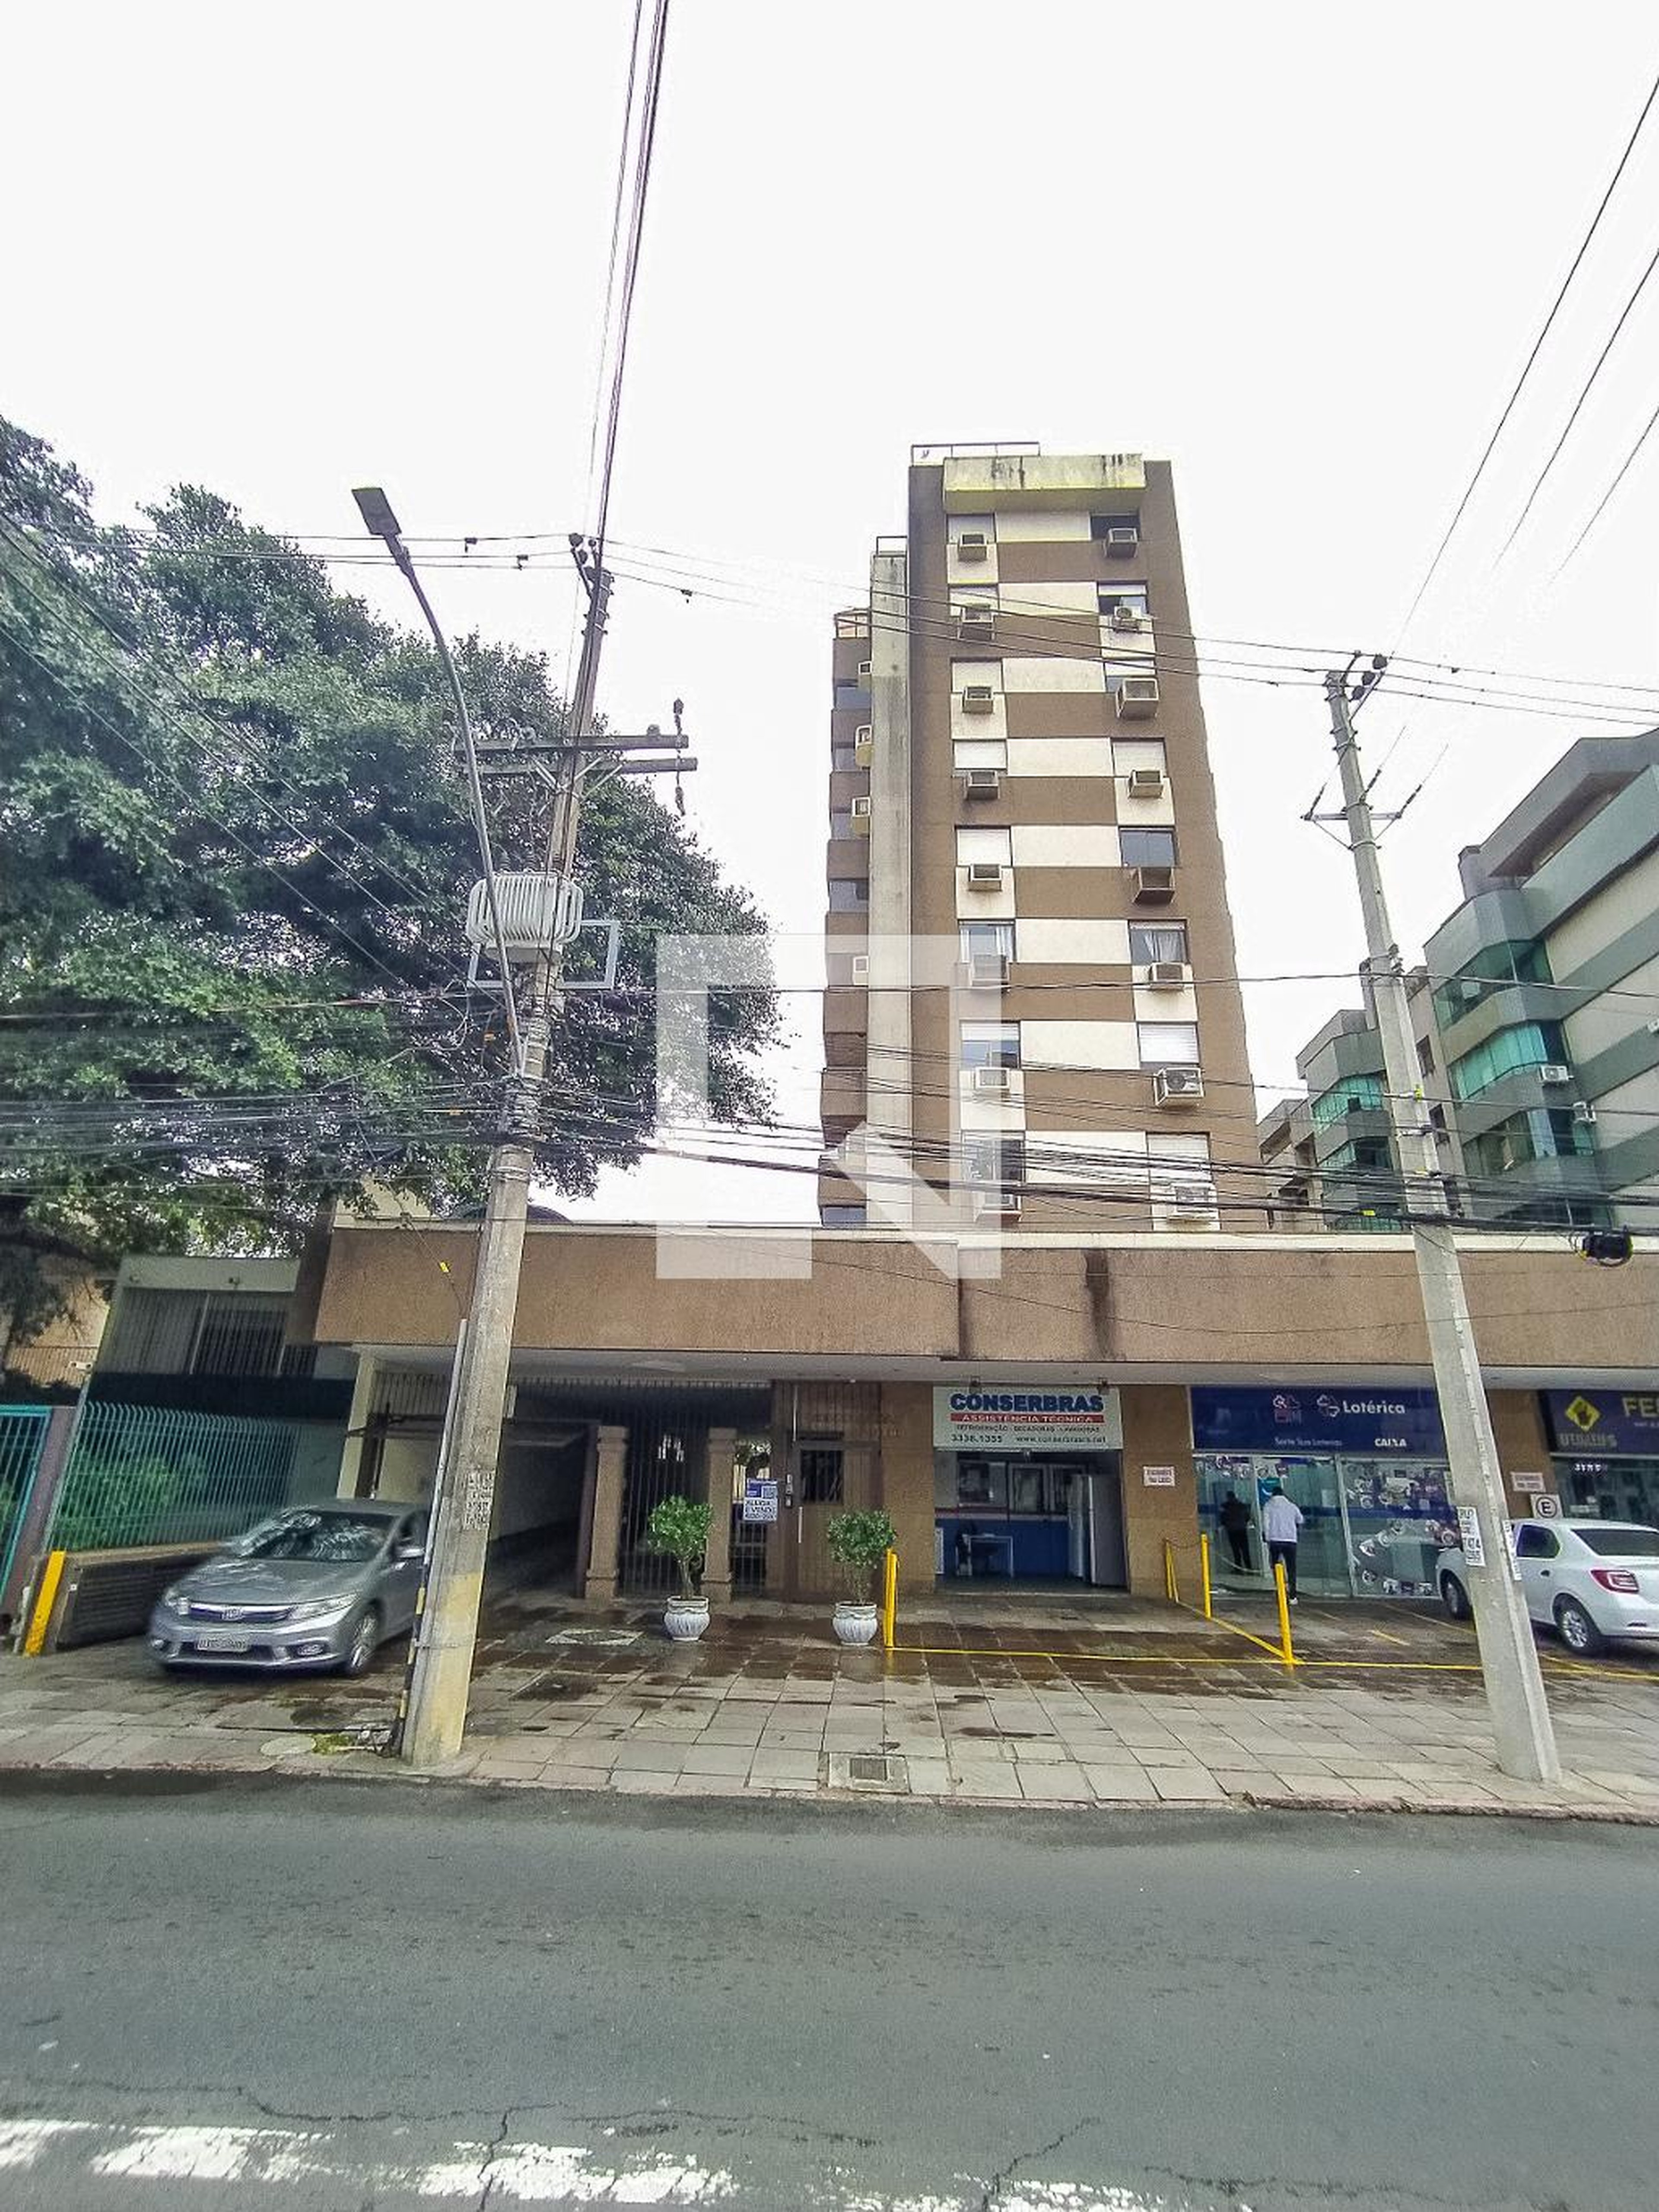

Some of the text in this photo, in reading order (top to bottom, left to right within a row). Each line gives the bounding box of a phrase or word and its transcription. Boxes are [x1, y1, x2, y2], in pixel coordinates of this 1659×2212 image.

[950, 1393, 1104, 1412] CONSERBRAS
[1342, 1400, 1406, 1414] Lotérica
[1622, 1397, 1659, 1418] FE
[1374, 1439, 1407, 1447] CAIXA
[1541, 1501, 1553, 1514] E
